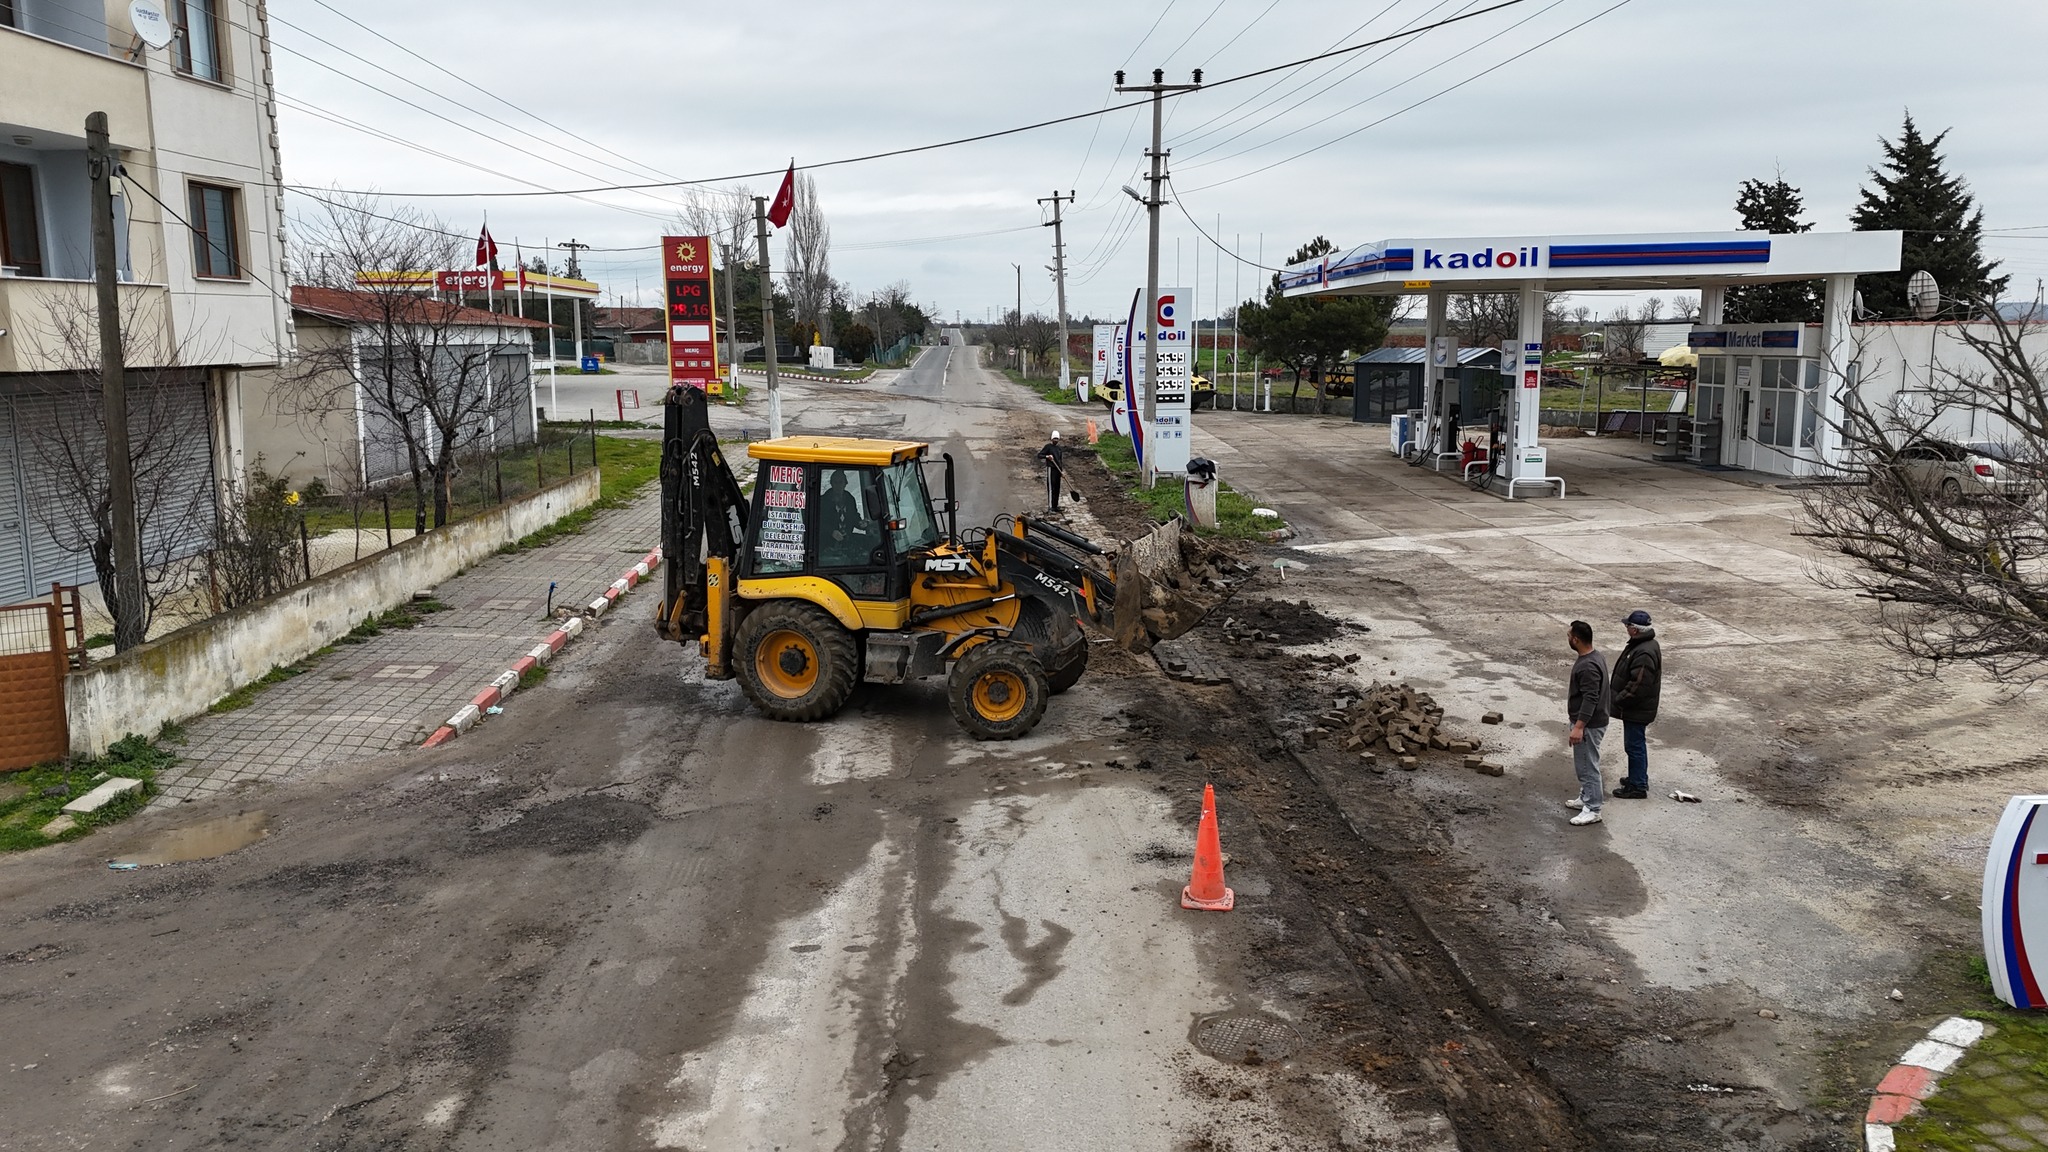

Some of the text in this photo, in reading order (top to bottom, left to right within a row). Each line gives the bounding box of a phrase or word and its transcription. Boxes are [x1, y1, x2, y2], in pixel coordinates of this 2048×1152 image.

[1424, 246, 1539, 269] kadoil
[670, 265, 704, 274] energy
[445, 275, 496, 288] energy
[676, 285, 701, 297] LPG
[1138, 331, 1186, 341] kdoil
[1728, 331, 1761, 348] Market
[690, 452, 700, 487] M542
[925, 558, 970, 571] MST
[1034, 572, 1070, 597] M542
